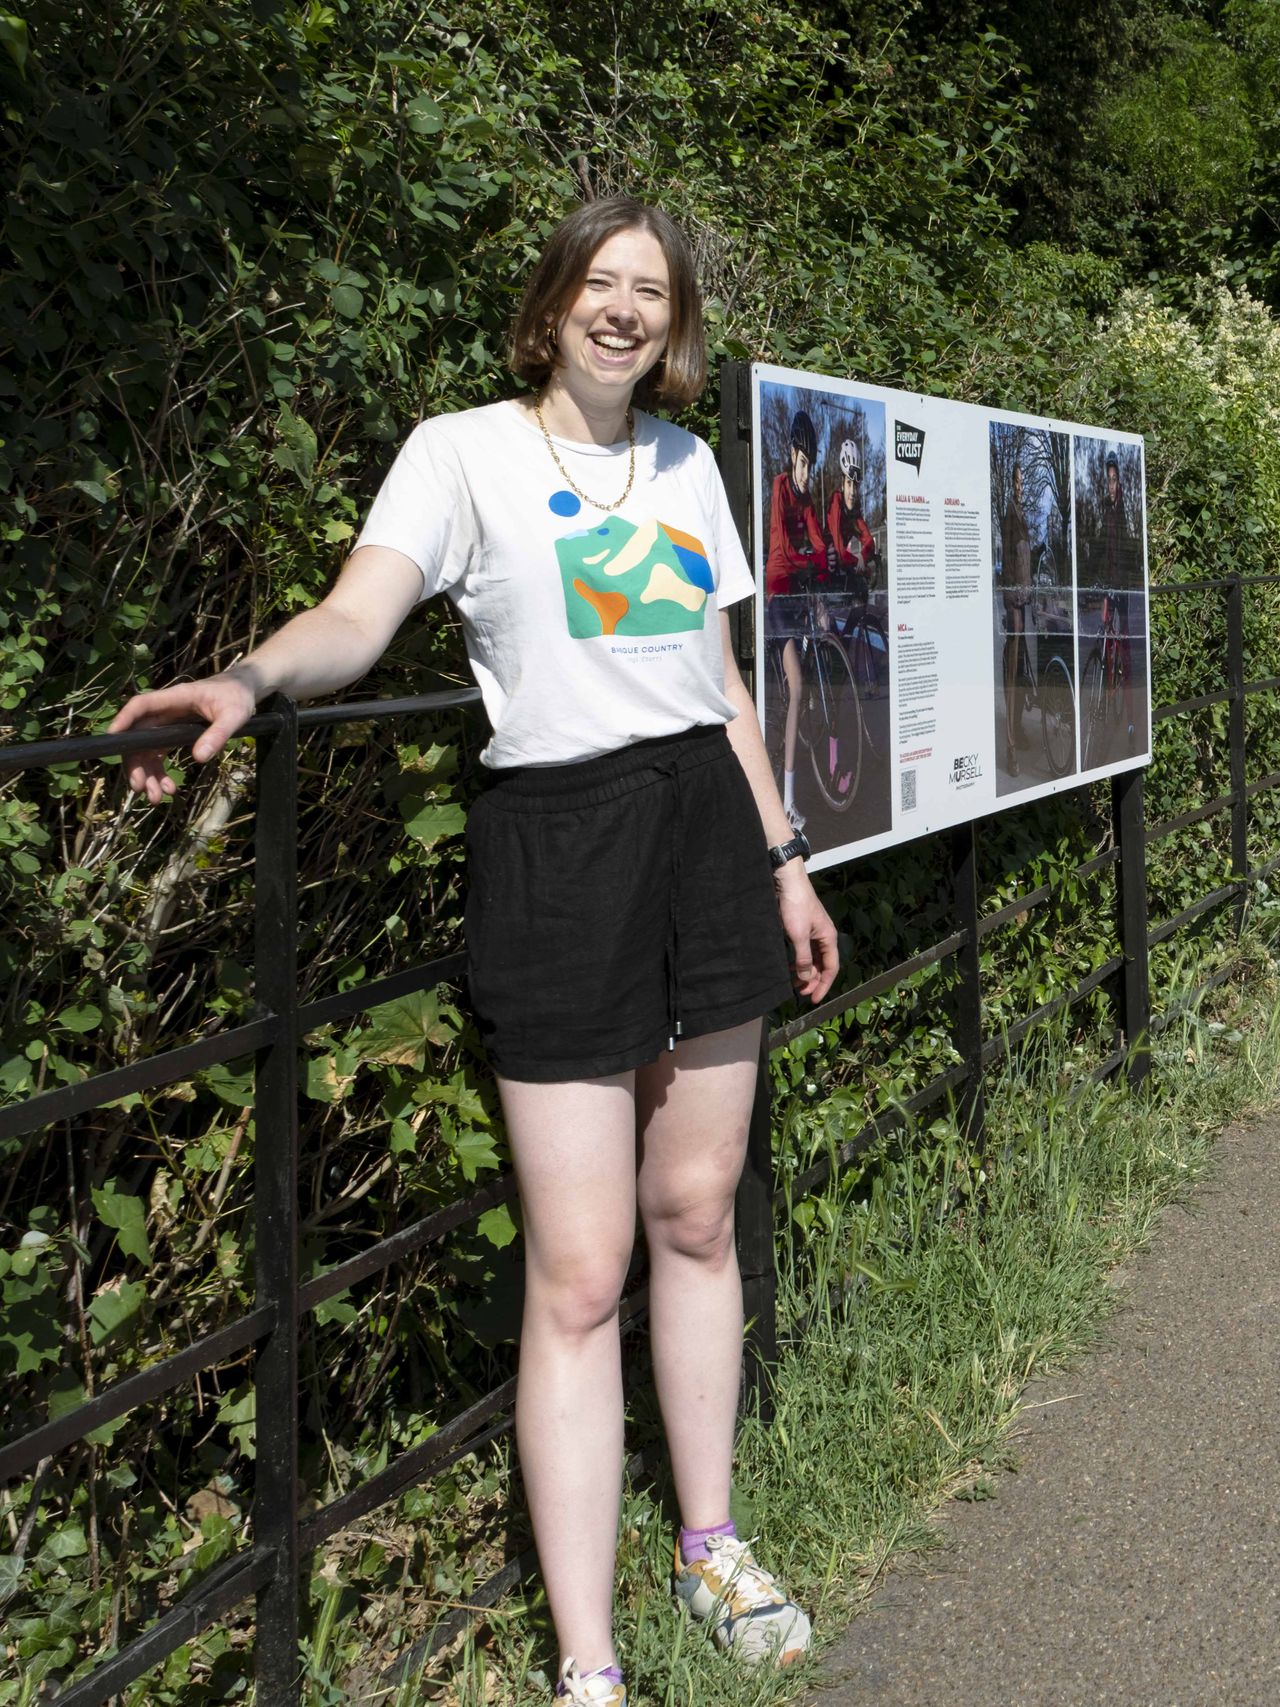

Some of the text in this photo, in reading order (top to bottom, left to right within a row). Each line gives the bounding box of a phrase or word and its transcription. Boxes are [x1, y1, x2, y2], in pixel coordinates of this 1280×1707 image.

[897, 432, 918, 442] EVERYDAY
[897, 443, 921, 458] CYCLIST
[641, 644, 683, 653] COUNTRY
[954, 753, 978, 770] BECKY
[949, 765, 982, 784] MURSELL
